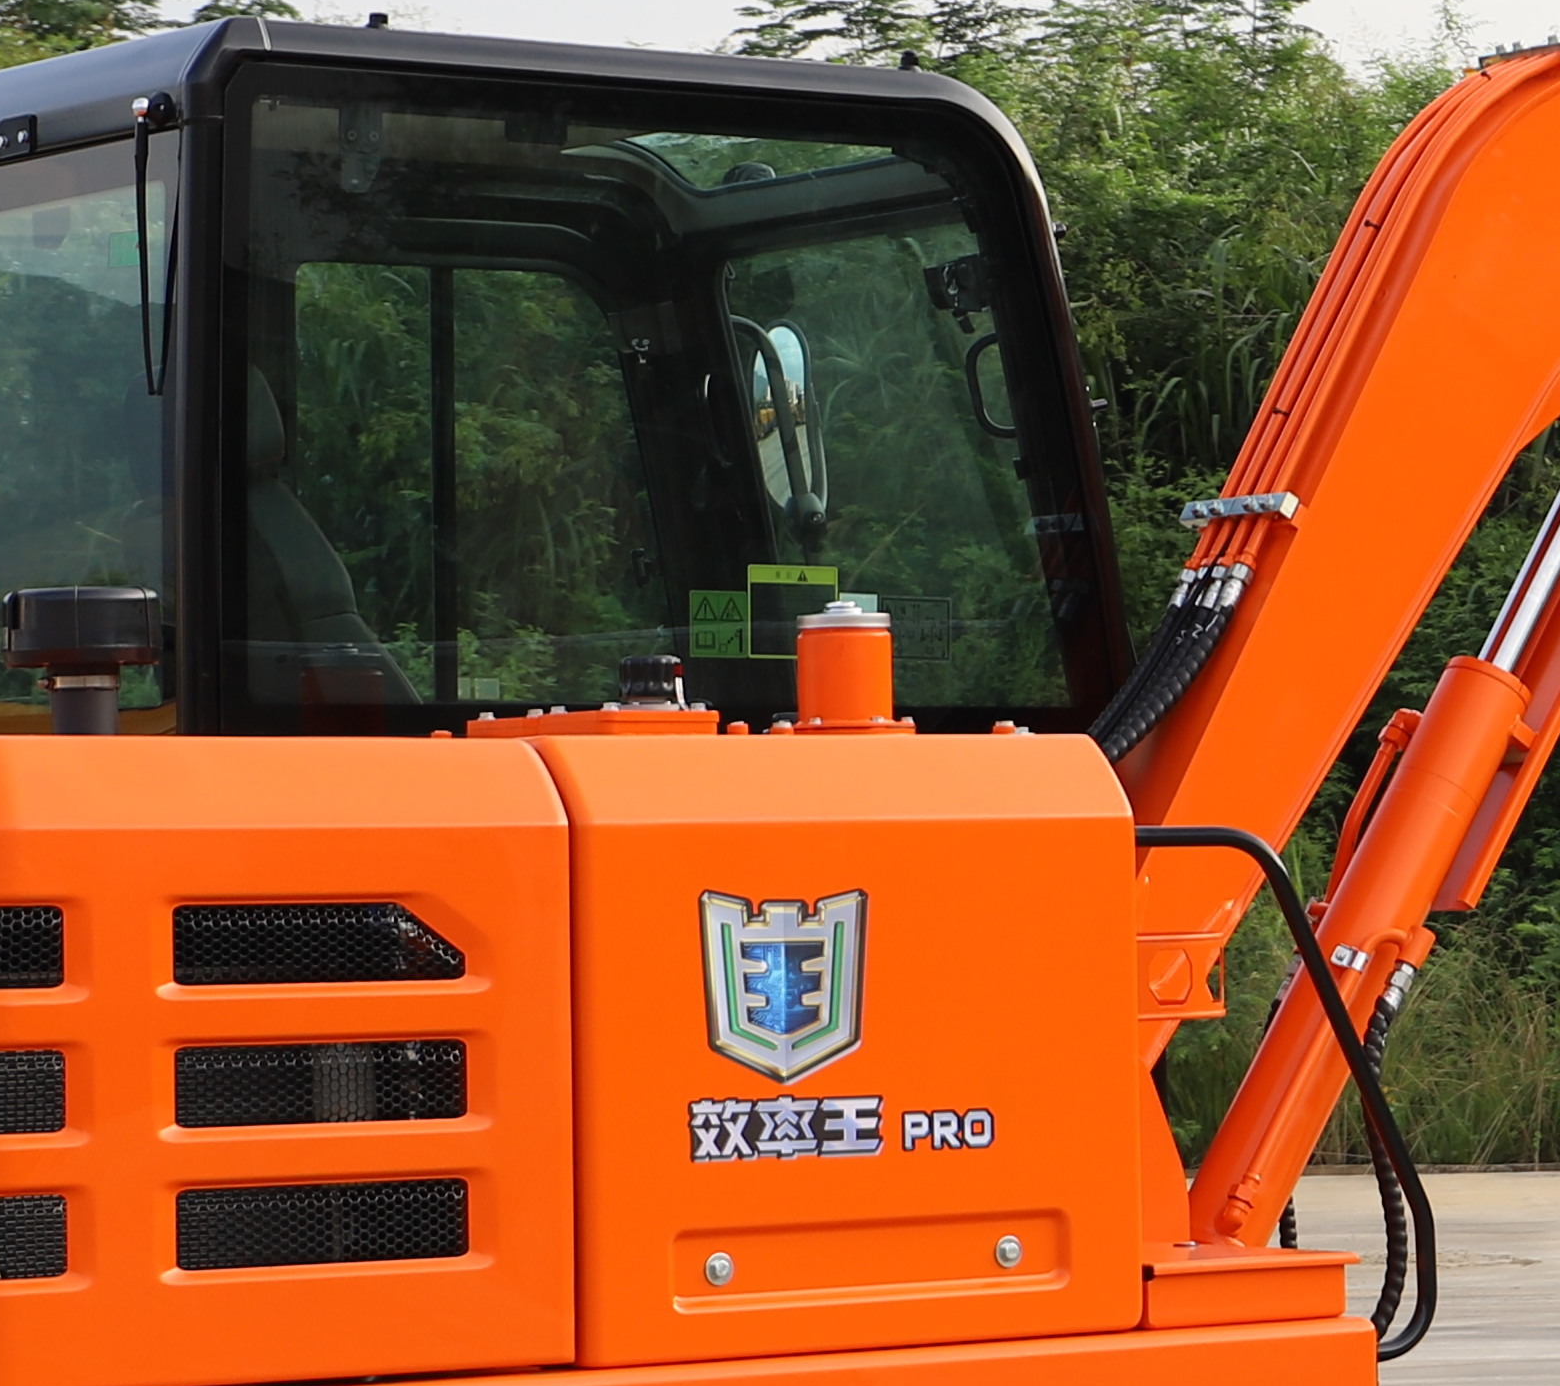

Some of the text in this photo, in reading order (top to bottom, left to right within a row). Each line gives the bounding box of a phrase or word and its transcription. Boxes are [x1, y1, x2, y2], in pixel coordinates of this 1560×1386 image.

[687, 1093, 996, 1163] 效率王 PRO
